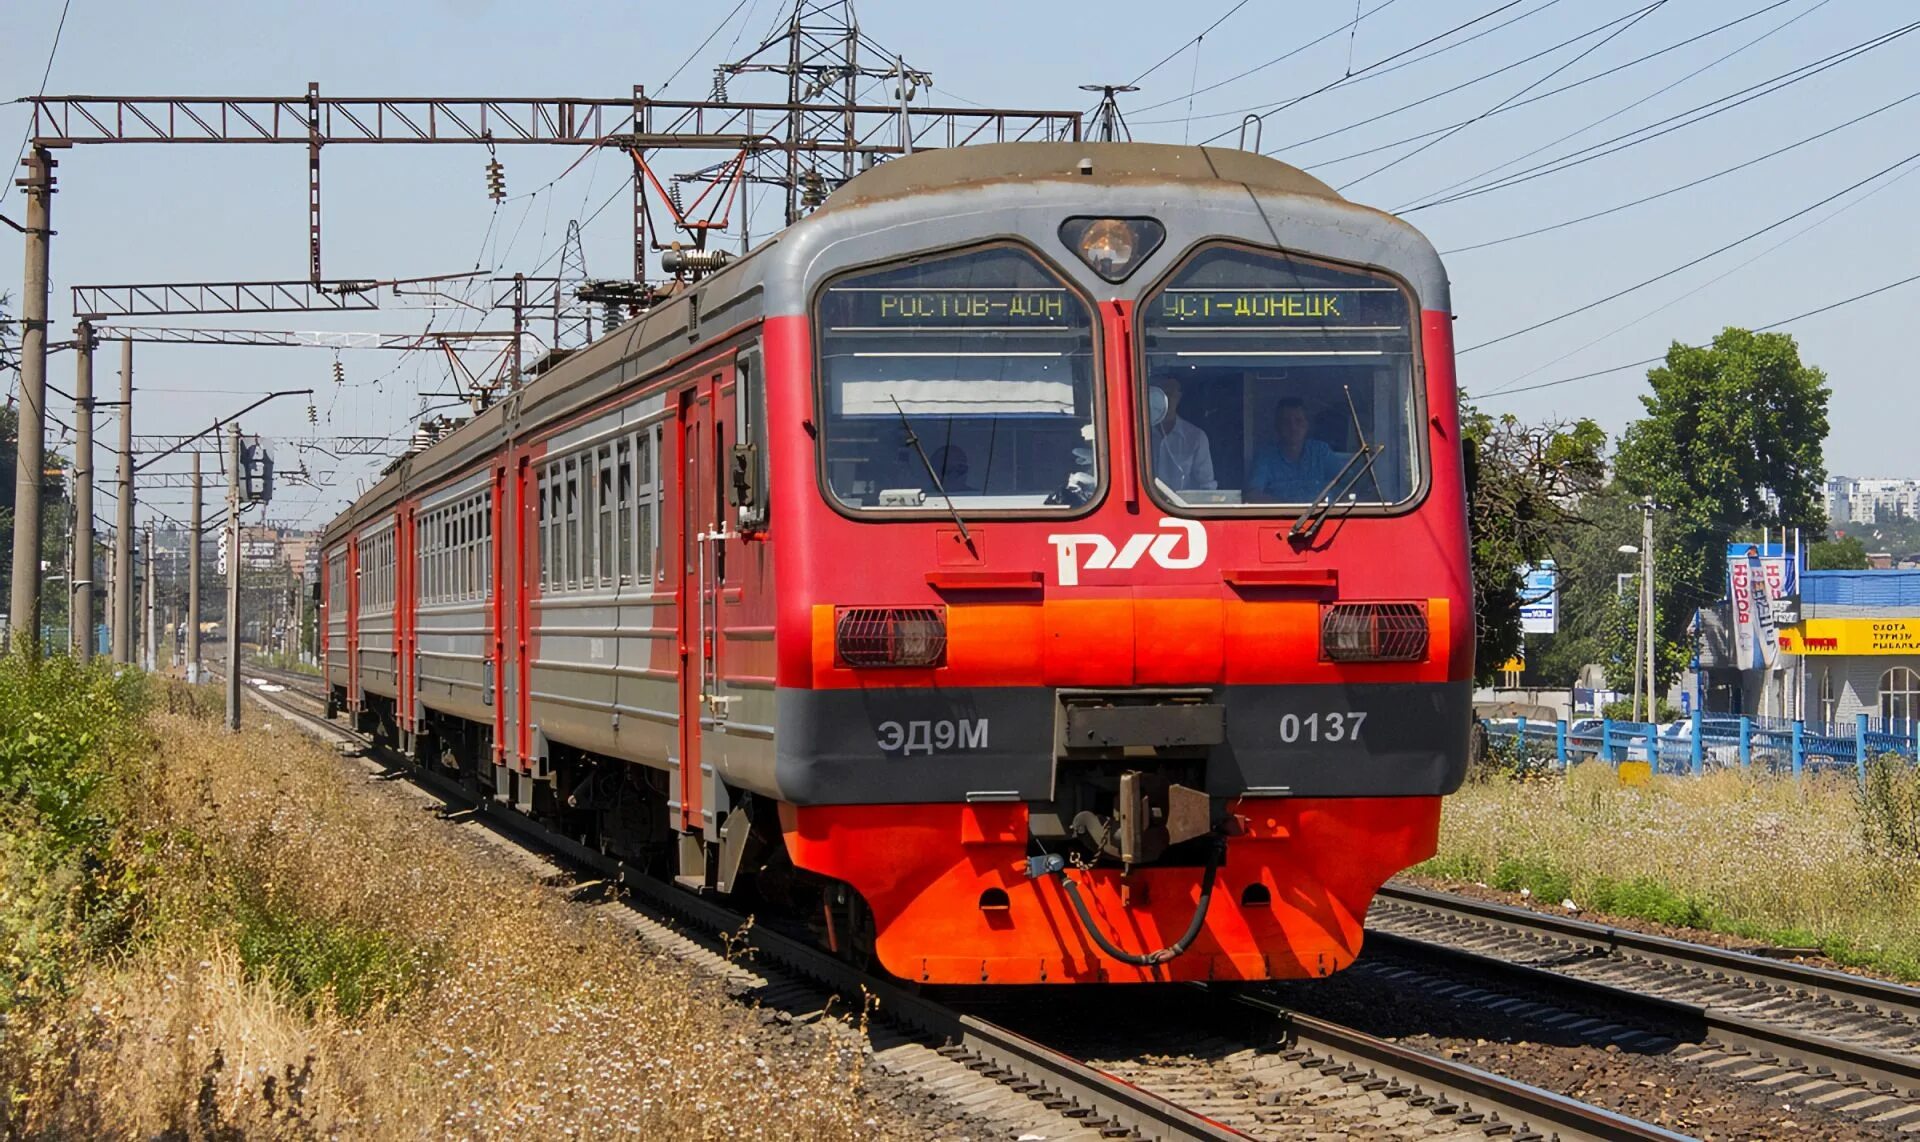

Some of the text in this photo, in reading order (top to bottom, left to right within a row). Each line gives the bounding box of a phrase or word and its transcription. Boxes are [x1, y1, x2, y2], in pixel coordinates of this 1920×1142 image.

[880, 294, 1063, 318] РОСТОВ-ДОН
[1162, 294, 1341, 317] УСТ-ДОНЕЦК
[877, 718, 989, 756] ЭД9М
[1280, 712, 1367, 743] 0137
